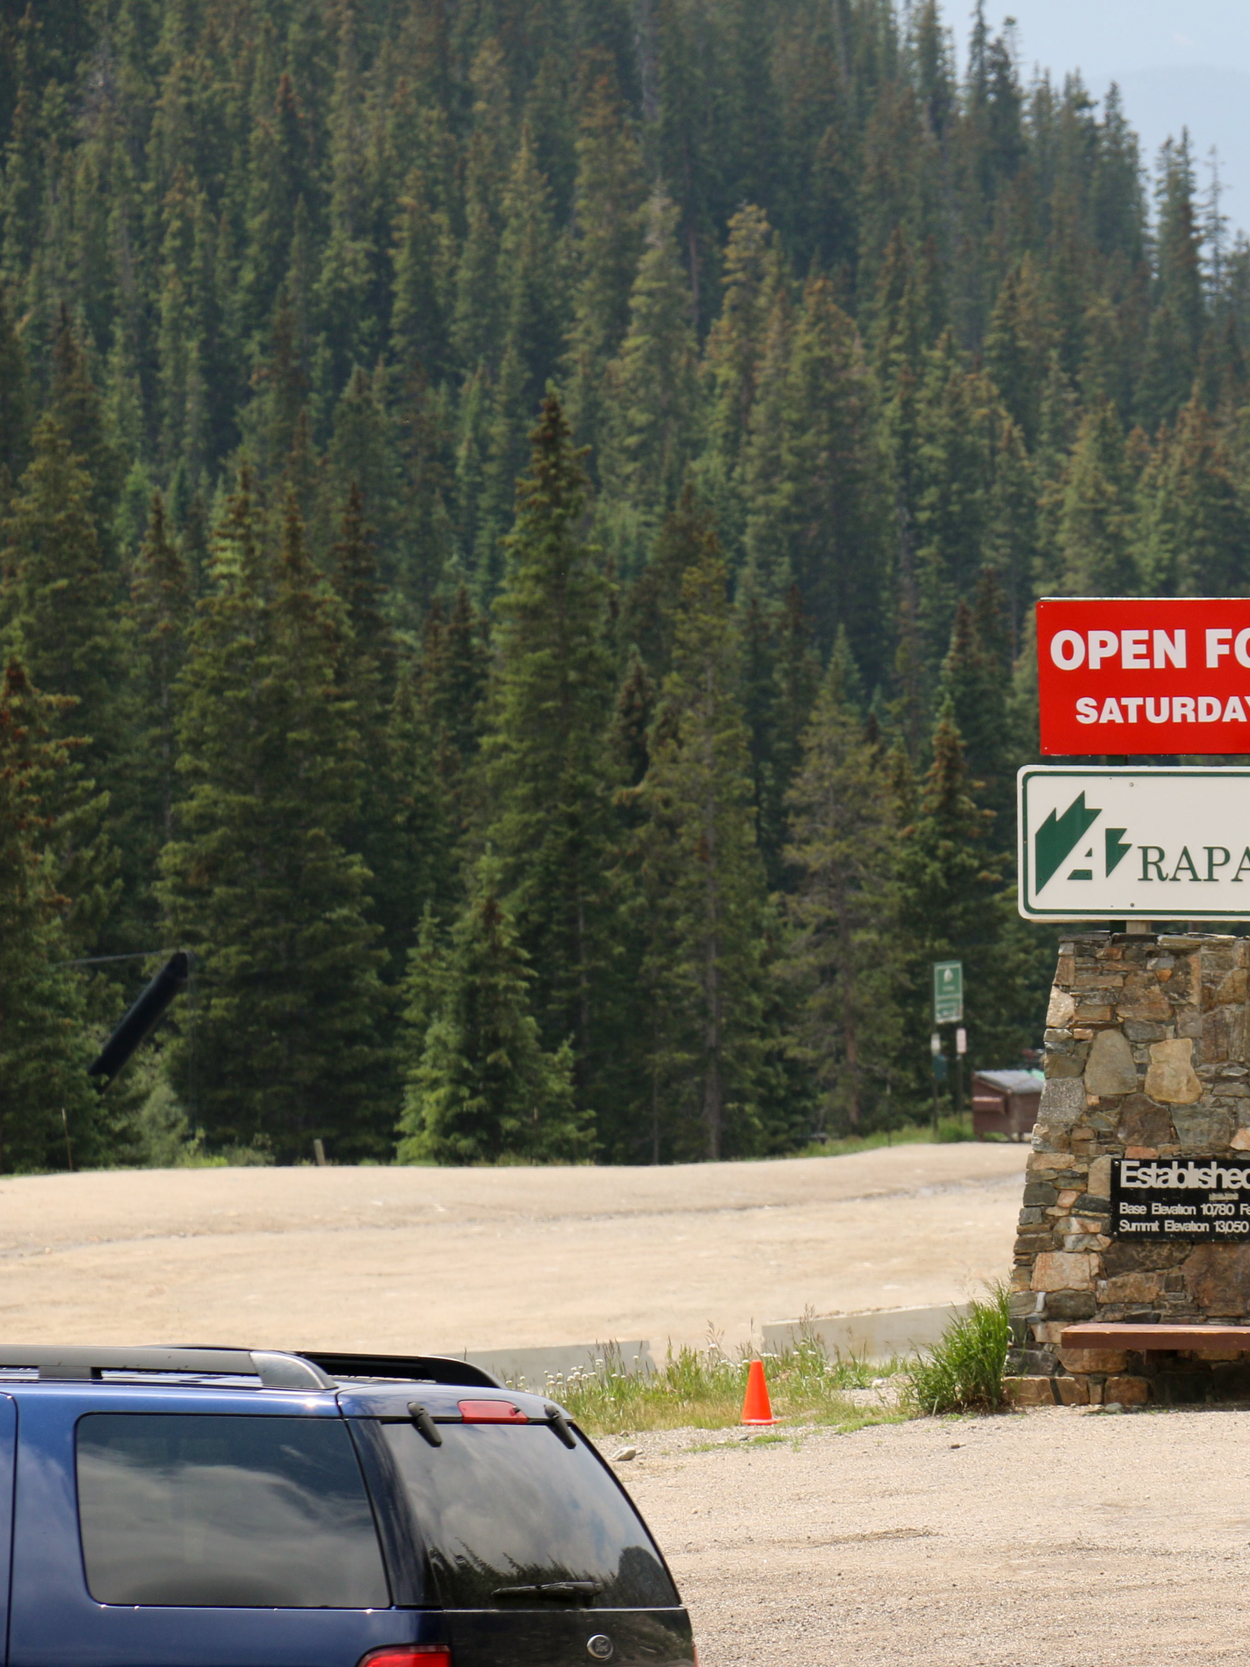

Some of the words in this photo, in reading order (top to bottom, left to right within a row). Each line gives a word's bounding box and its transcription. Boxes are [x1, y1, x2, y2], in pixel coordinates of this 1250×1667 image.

[1050, 629, 1187, 671] OPEN
[1119, 1202, 1147, 1216] Base
[1151, 1202, 1197, 1216] Elevation
[1200, 1203, 1235, 1217] 10,780
[1118, 1219, 1160, 1233] Summit
[1164, 1219, 1210, 1233] Elevation
[1213, 1220, 1250, 1234] 13,050
